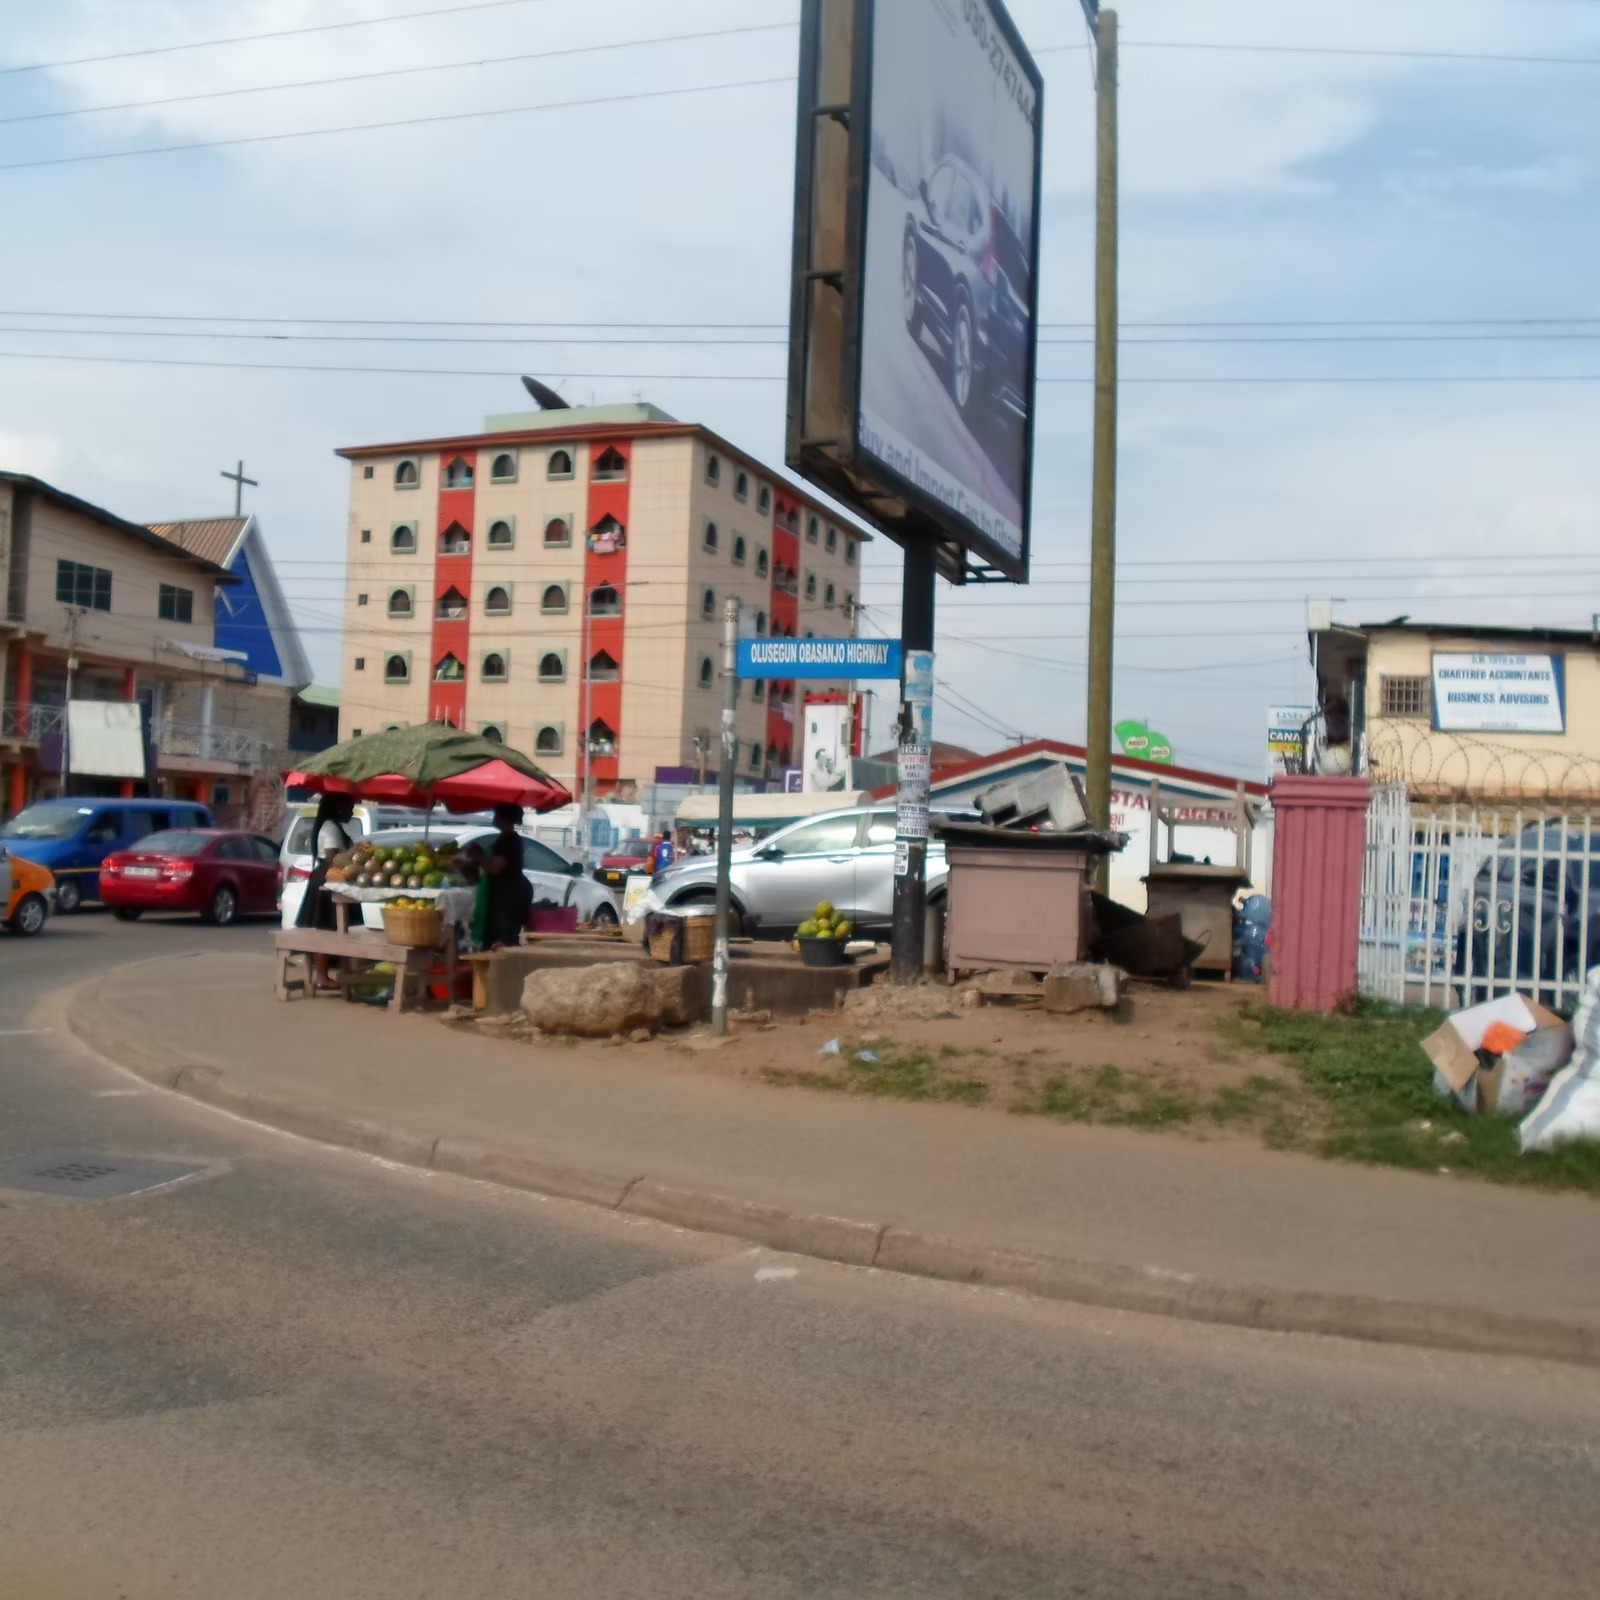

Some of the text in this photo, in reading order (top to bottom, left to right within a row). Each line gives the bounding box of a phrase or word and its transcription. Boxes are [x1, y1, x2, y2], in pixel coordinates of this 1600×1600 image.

[887, 444, 912, 480] and
[751, 643, 889, 665] OLUSEGUN OBASANJO HIGHWAY
[1439, 669, 1551, 681] CHARTERED ACCOUNTANTS
[1448, 692, 1550, 705] BUSINESS ADVISORS
[1270, 732, 1301, 741] CANA
